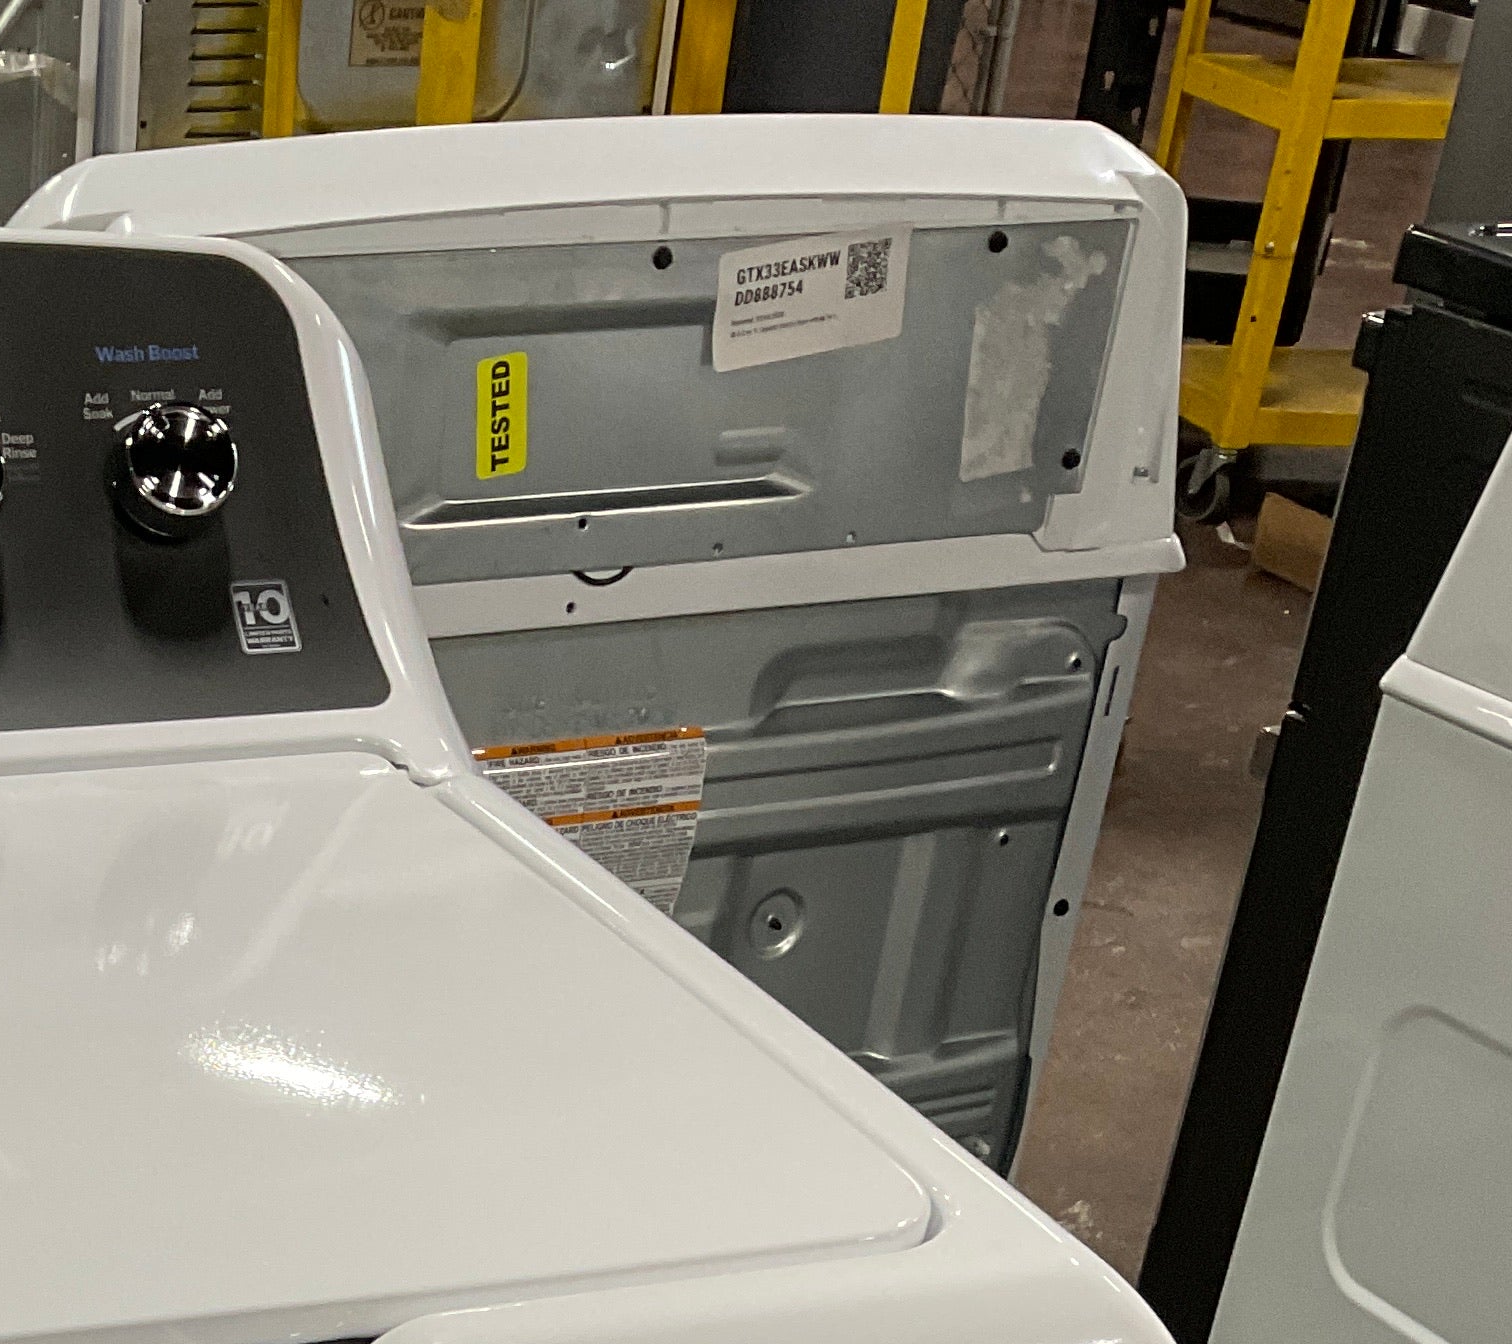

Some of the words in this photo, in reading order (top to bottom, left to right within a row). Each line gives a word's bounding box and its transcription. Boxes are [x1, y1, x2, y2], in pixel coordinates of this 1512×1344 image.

[736, 250, 841, 285] GTX33EASKWW
[734, 279, 804, 306] DD888754
[95, 346, 145, 363] Wash
[147, 343, 199, 362] Boost
[85, 392, 110, 405] Add
[199, 387, 223, 401] Add
[83, 407, 113, 420] Soak
[490, 360, 510, 472] TESTED
[1, 432, 35, 446] Deep
[3, 447, 37, 460] Rinse
